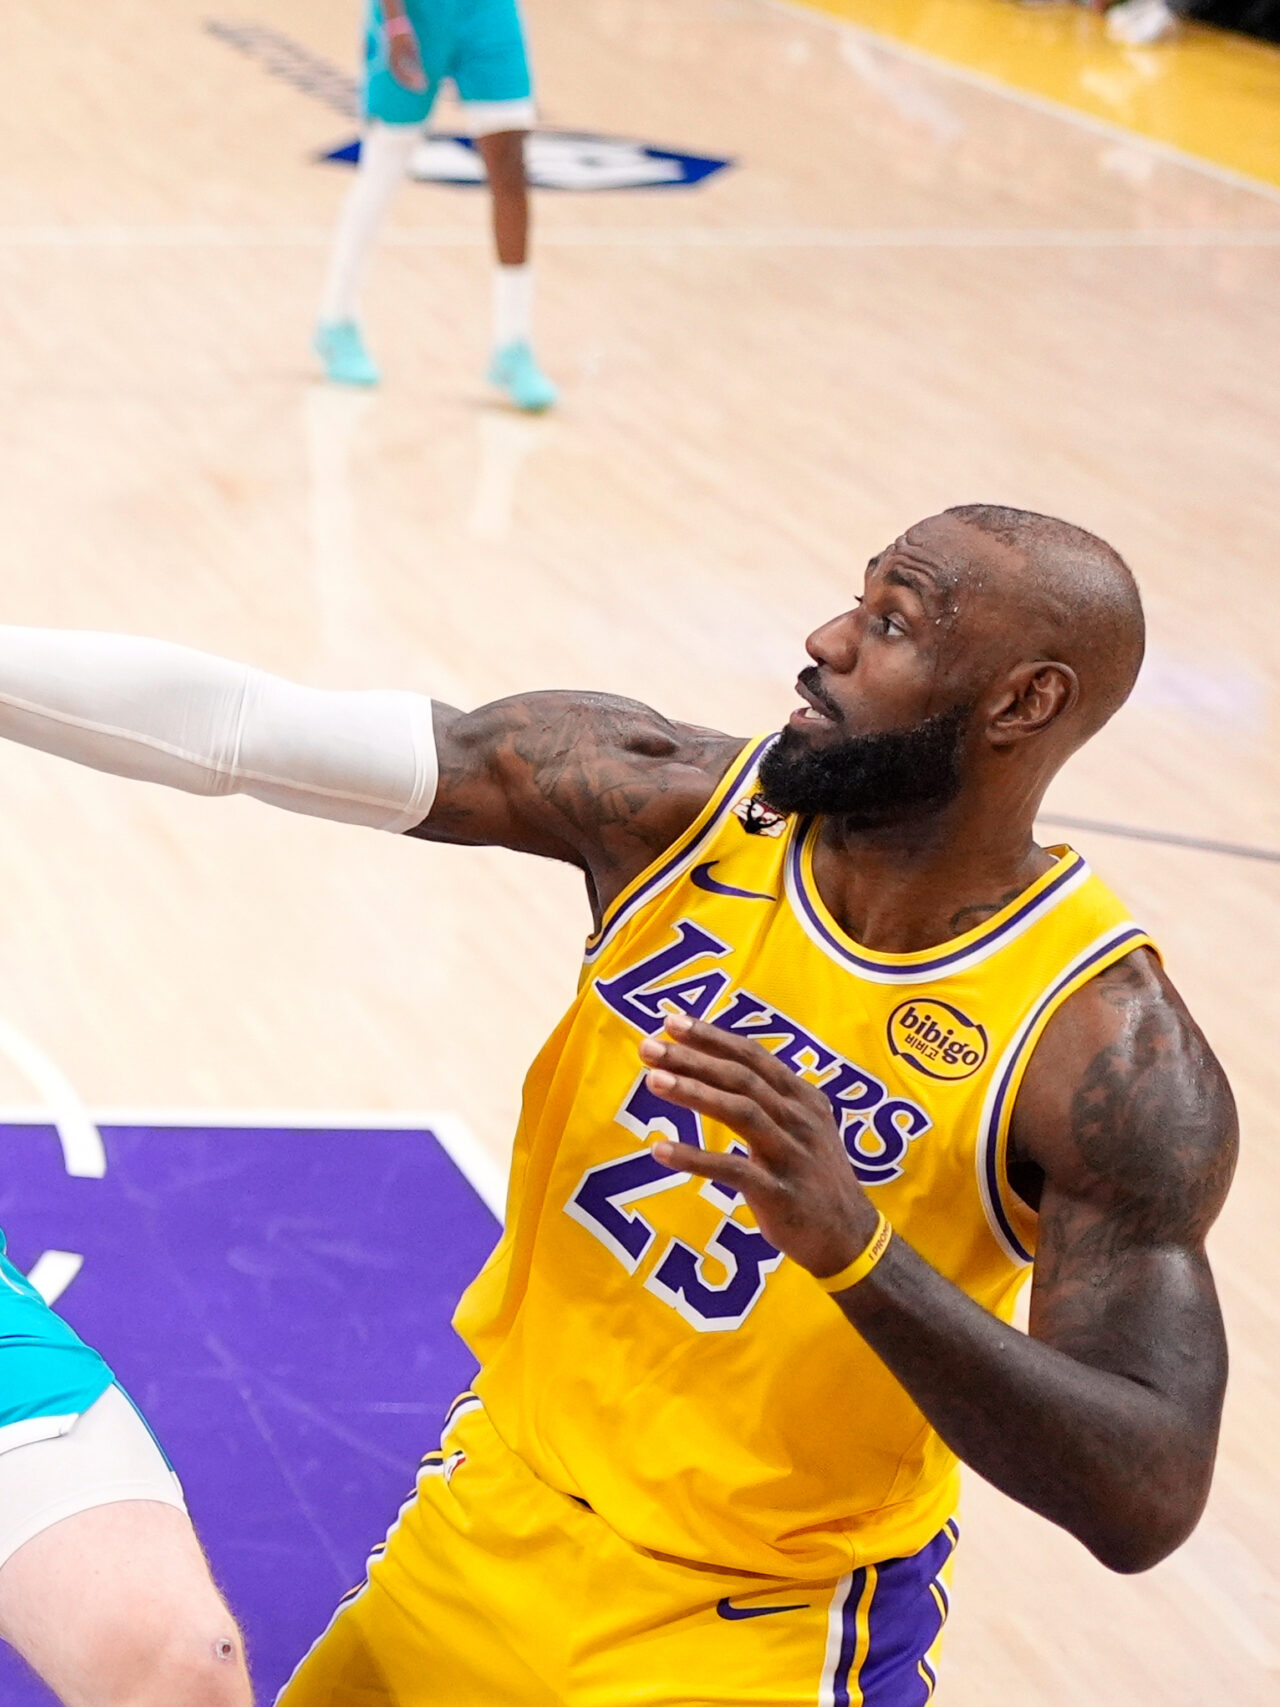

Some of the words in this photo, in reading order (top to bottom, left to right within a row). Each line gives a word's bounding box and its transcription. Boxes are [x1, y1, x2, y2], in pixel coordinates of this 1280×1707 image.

[899, 1006, 980, 1066] bibigo
[904, 1033, 940, 1061] 비비고
[563, 1066, 786, 1332] 23
